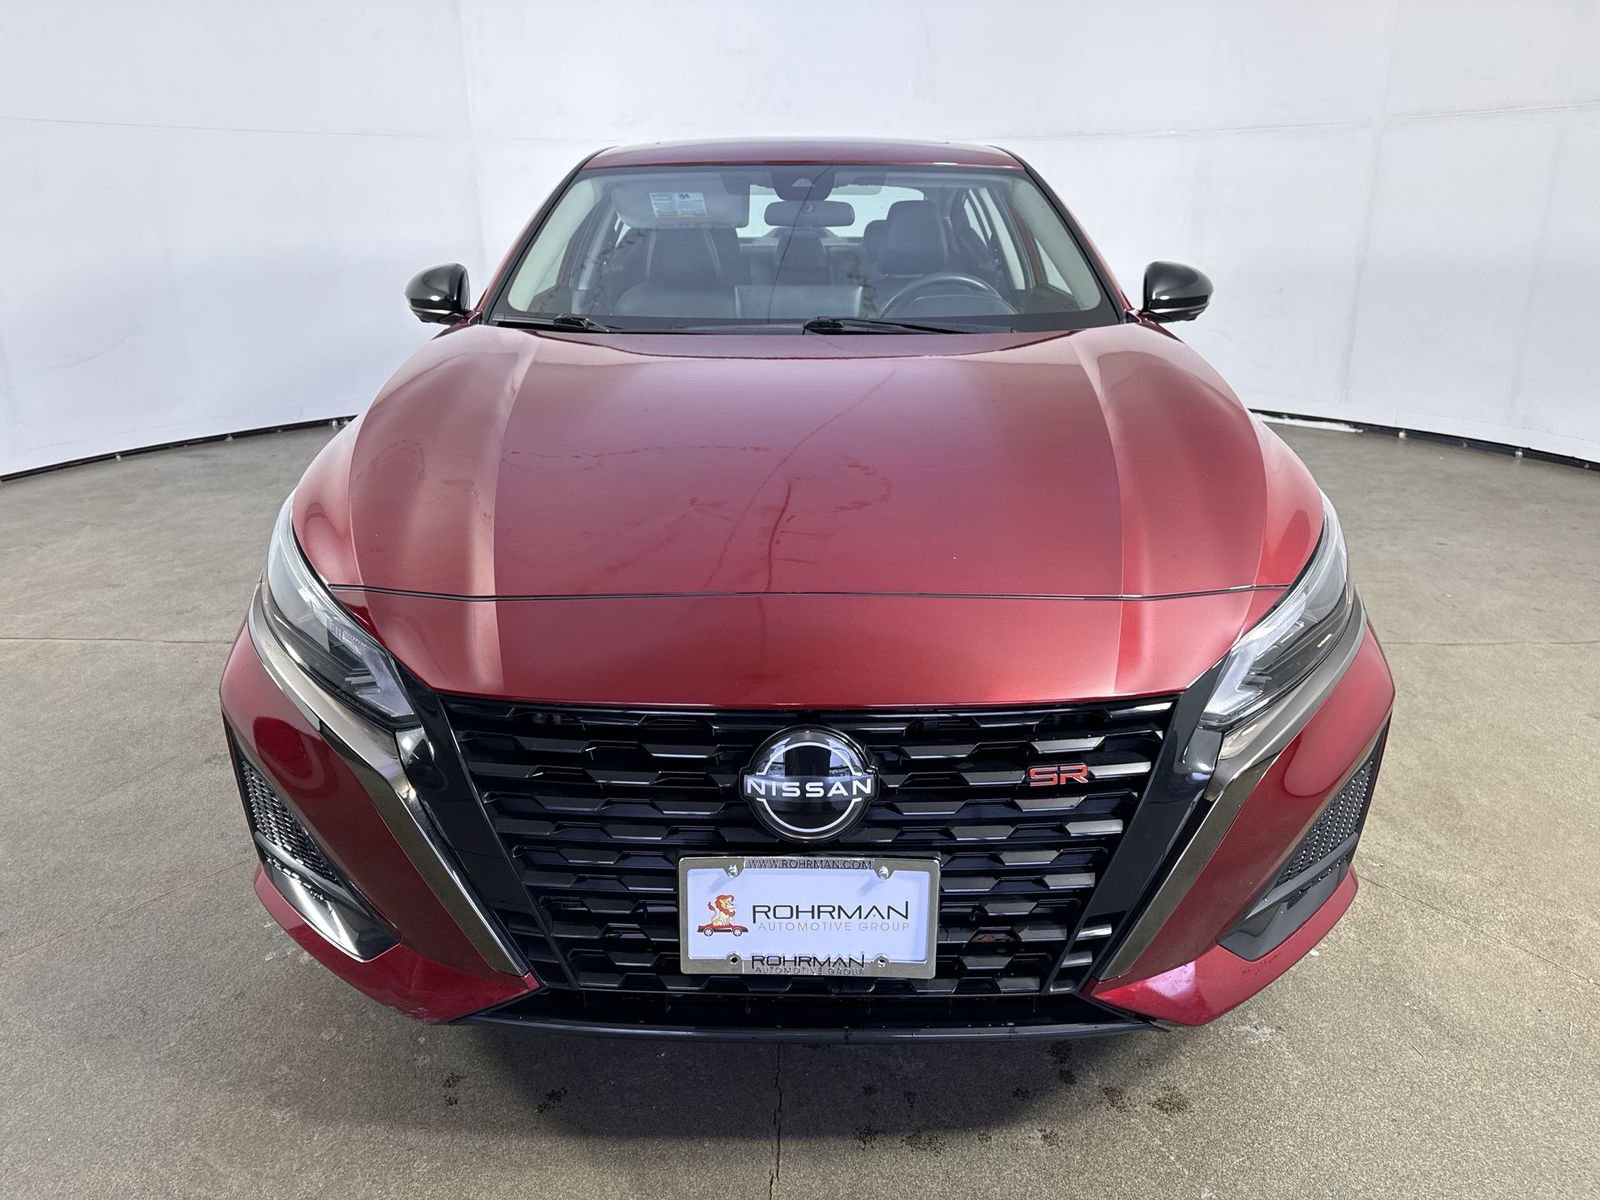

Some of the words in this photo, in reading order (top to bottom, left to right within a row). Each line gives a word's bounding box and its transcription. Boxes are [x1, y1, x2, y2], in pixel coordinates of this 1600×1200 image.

[1028, 762, 1089, 787] SR
[747, 778, 872, 798] NISSAN
[748, 859, 873, 870] WWW.ROHRMAN.COM
[752, 901, 909, 924] ROHRMAN
[757, 922, 851, 932] AUTOMOTIVE
[858, 922, 910, 932] GROUP
[751, 954, 865, 969] ROHRMAN
[754, 967, 823, 975] AUTOMOTIVE
[828, 968, 865, 976] GROUP
